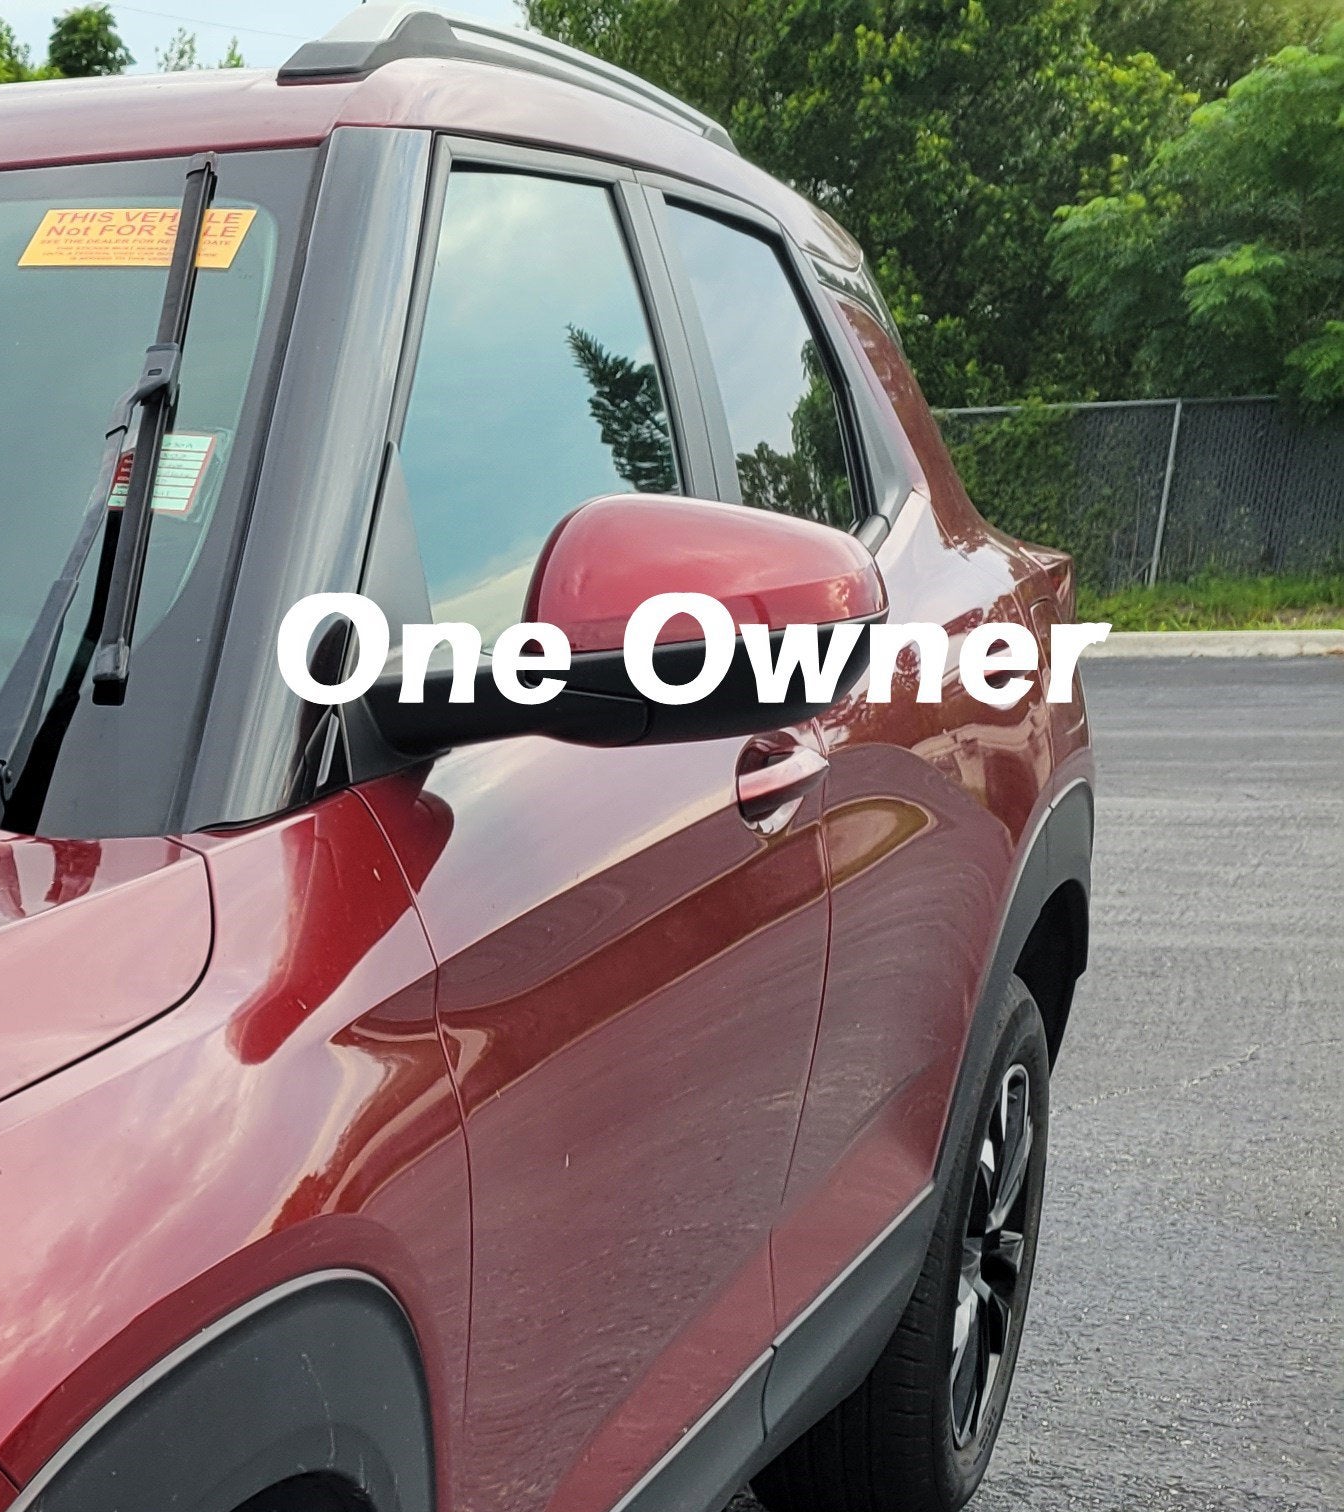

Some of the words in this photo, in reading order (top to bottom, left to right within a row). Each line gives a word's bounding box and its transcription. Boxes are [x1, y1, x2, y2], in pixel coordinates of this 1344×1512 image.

[56, 212, 113, 224] THIS
[125, 211, 244, 224] VEHLE
[46, 225, 93, 237] Not
[98, 225, 156, 237] FOR
[164, 226, 240, 238] SLE
